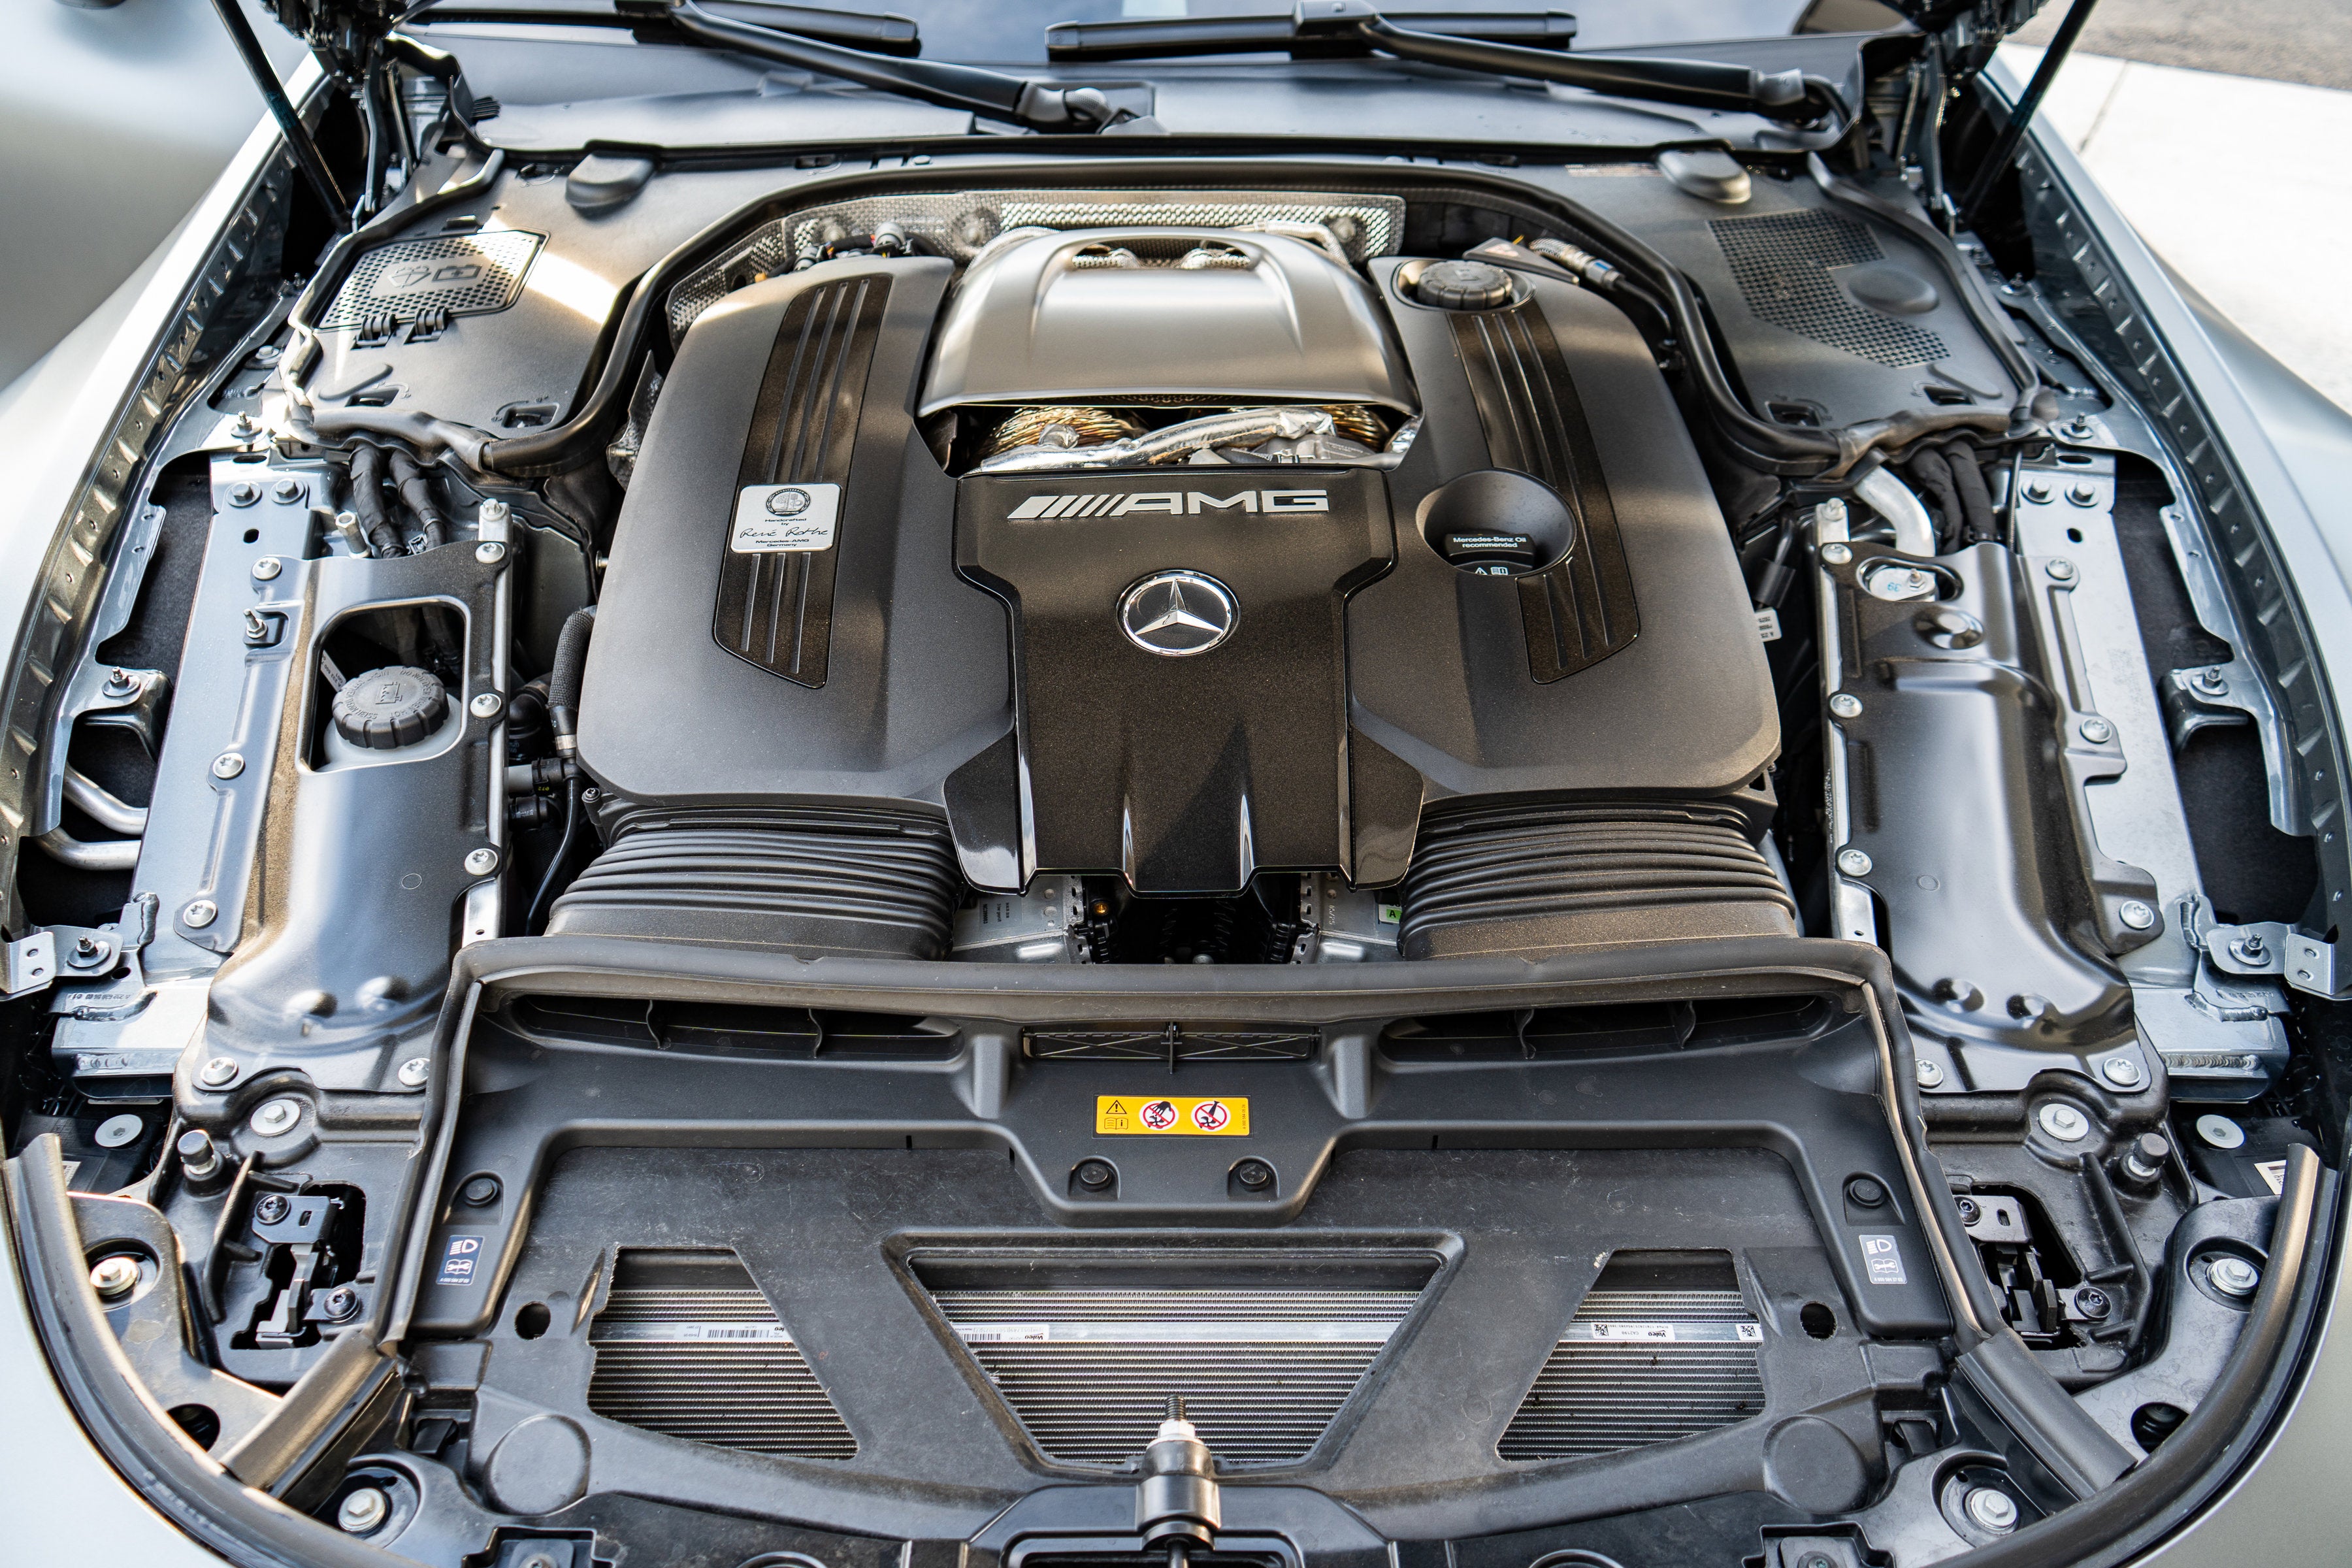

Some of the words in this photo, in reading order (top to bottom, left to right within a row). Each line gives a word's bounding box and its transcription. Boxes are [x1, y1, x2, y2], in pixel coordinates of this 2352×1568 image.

[1109, 490, 1329, 516] AMG
[785, 527, 828, 537] Rothe
[1389, 909, 1396, 918] A
